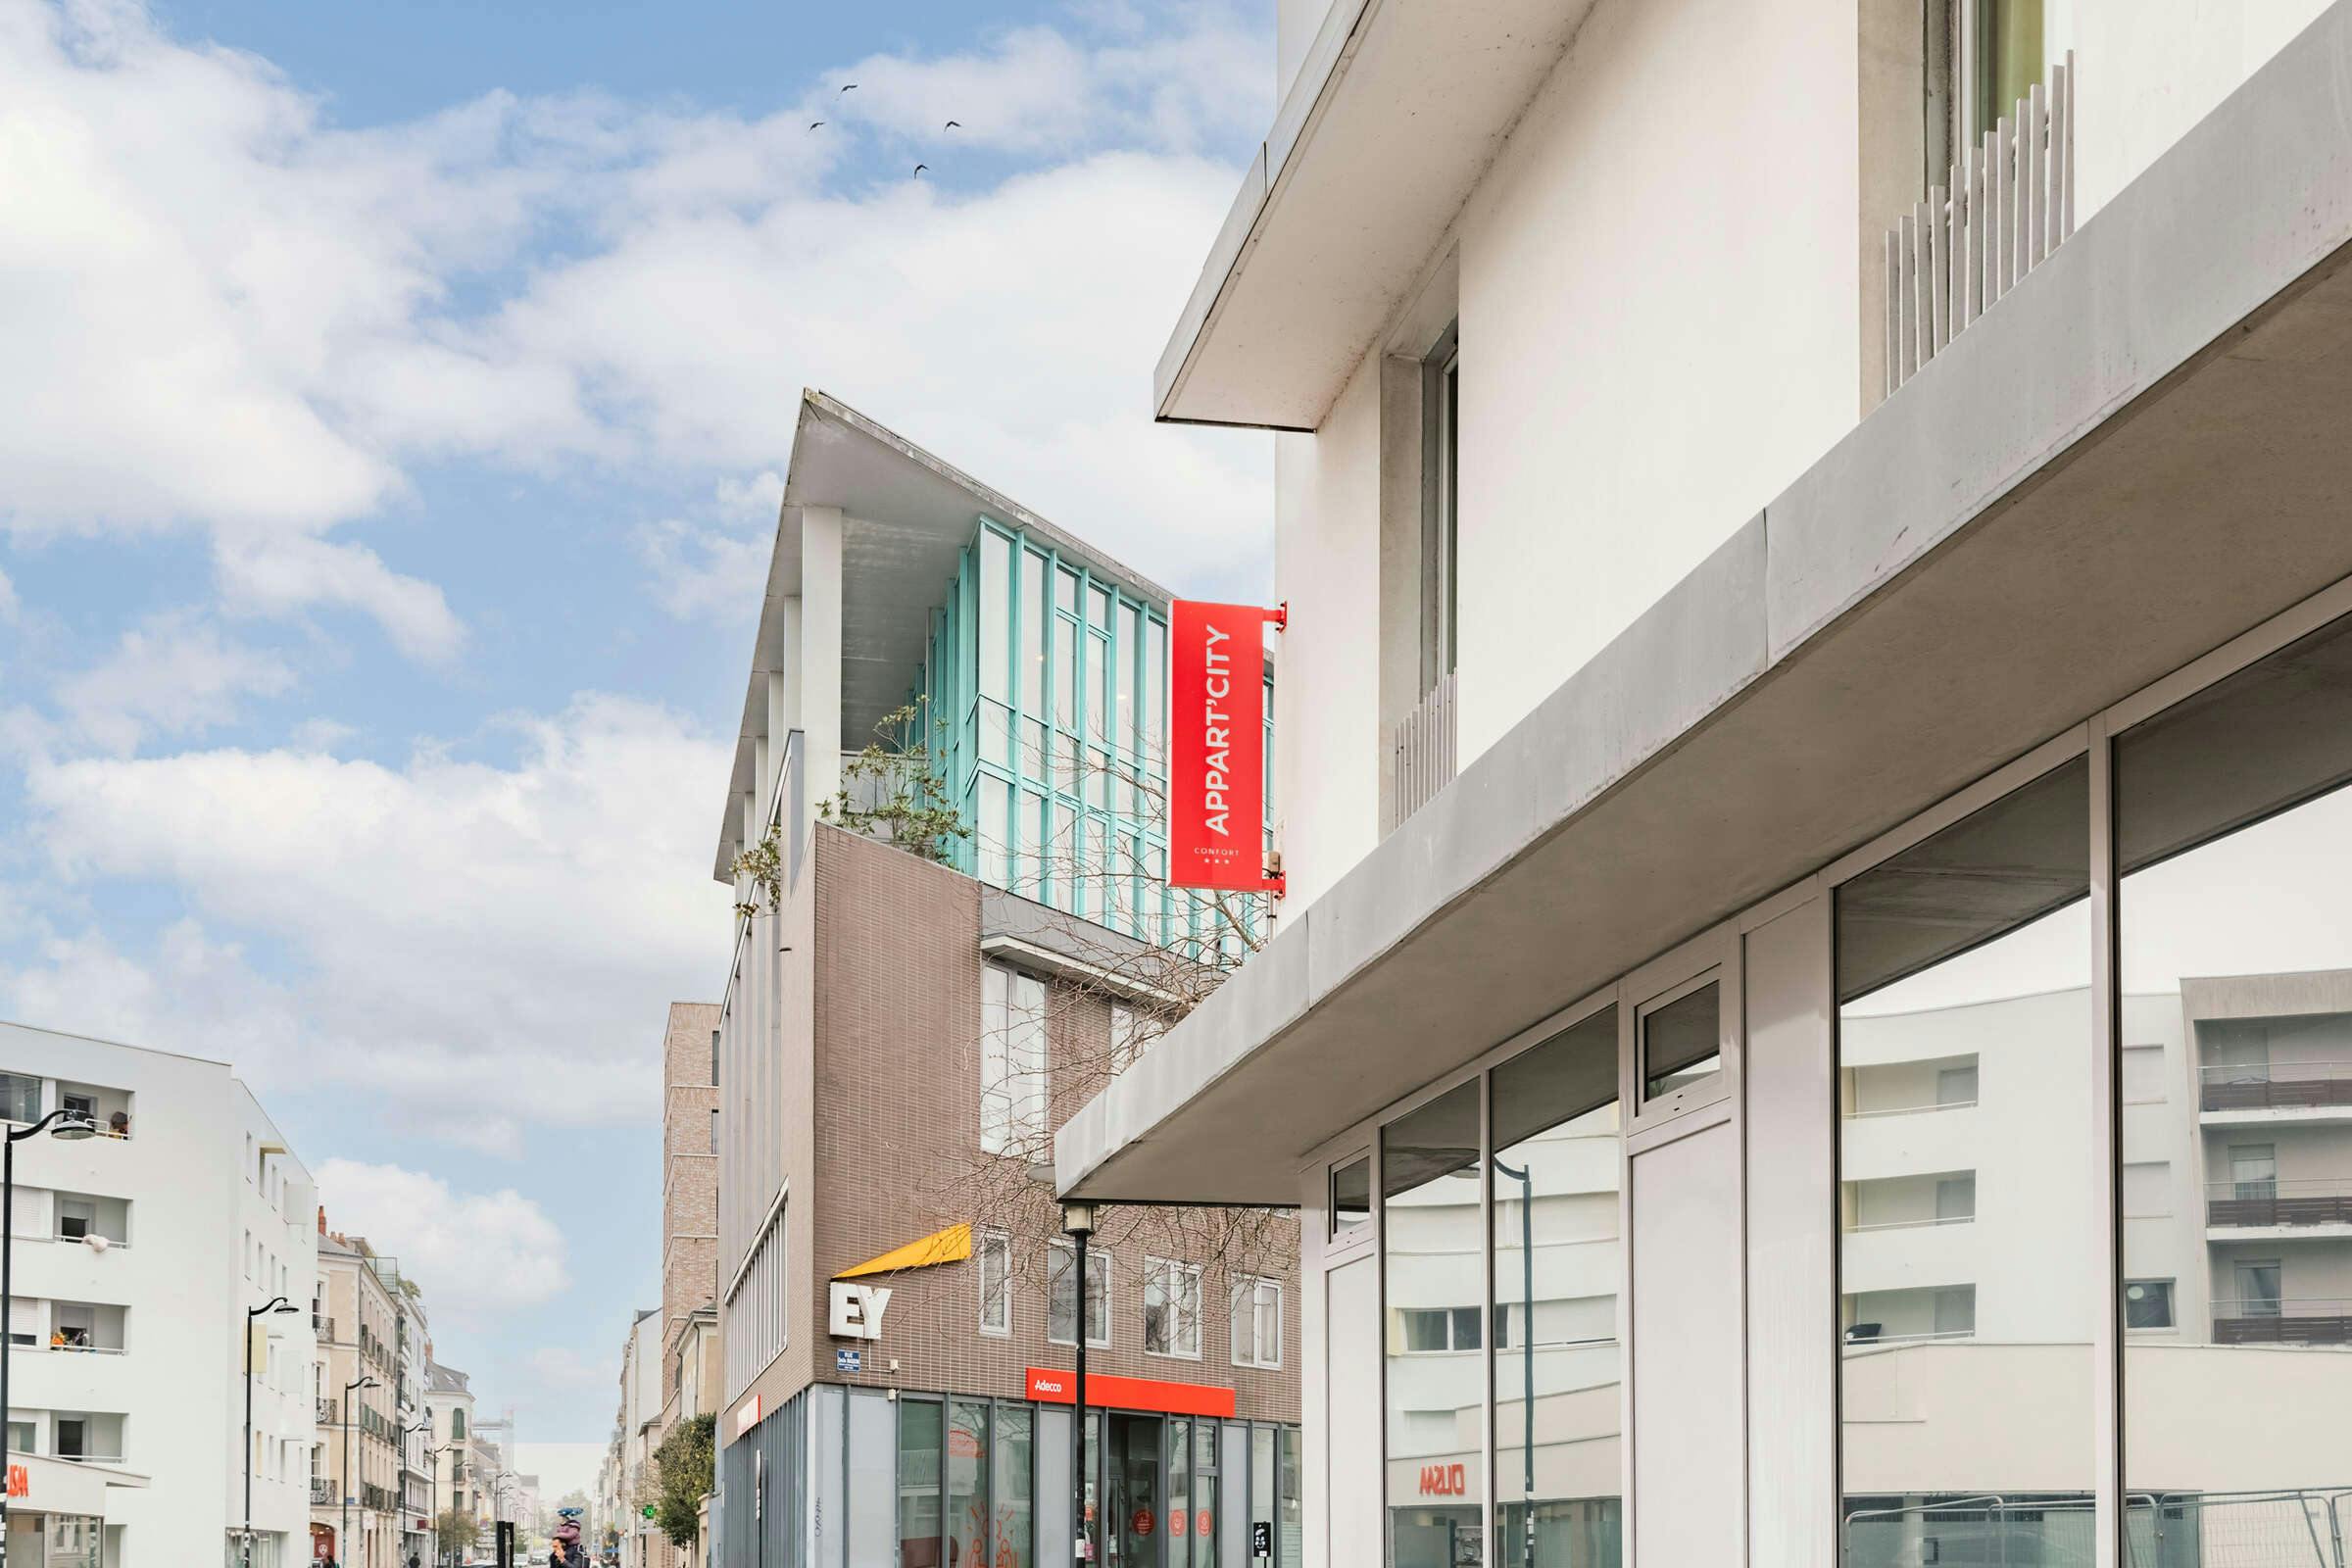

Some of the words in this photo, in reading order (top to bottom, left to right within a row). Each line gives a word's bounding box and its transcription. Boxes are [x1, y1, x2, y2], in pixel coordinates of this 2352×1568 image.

[1205, 624, 1230, 836] APPART'CITY
[1194, 847, 1240, 857] CONFORT
[830, 1282, 893, 1340] EY
[1034, 1379, 1062, 1393] Adecco
